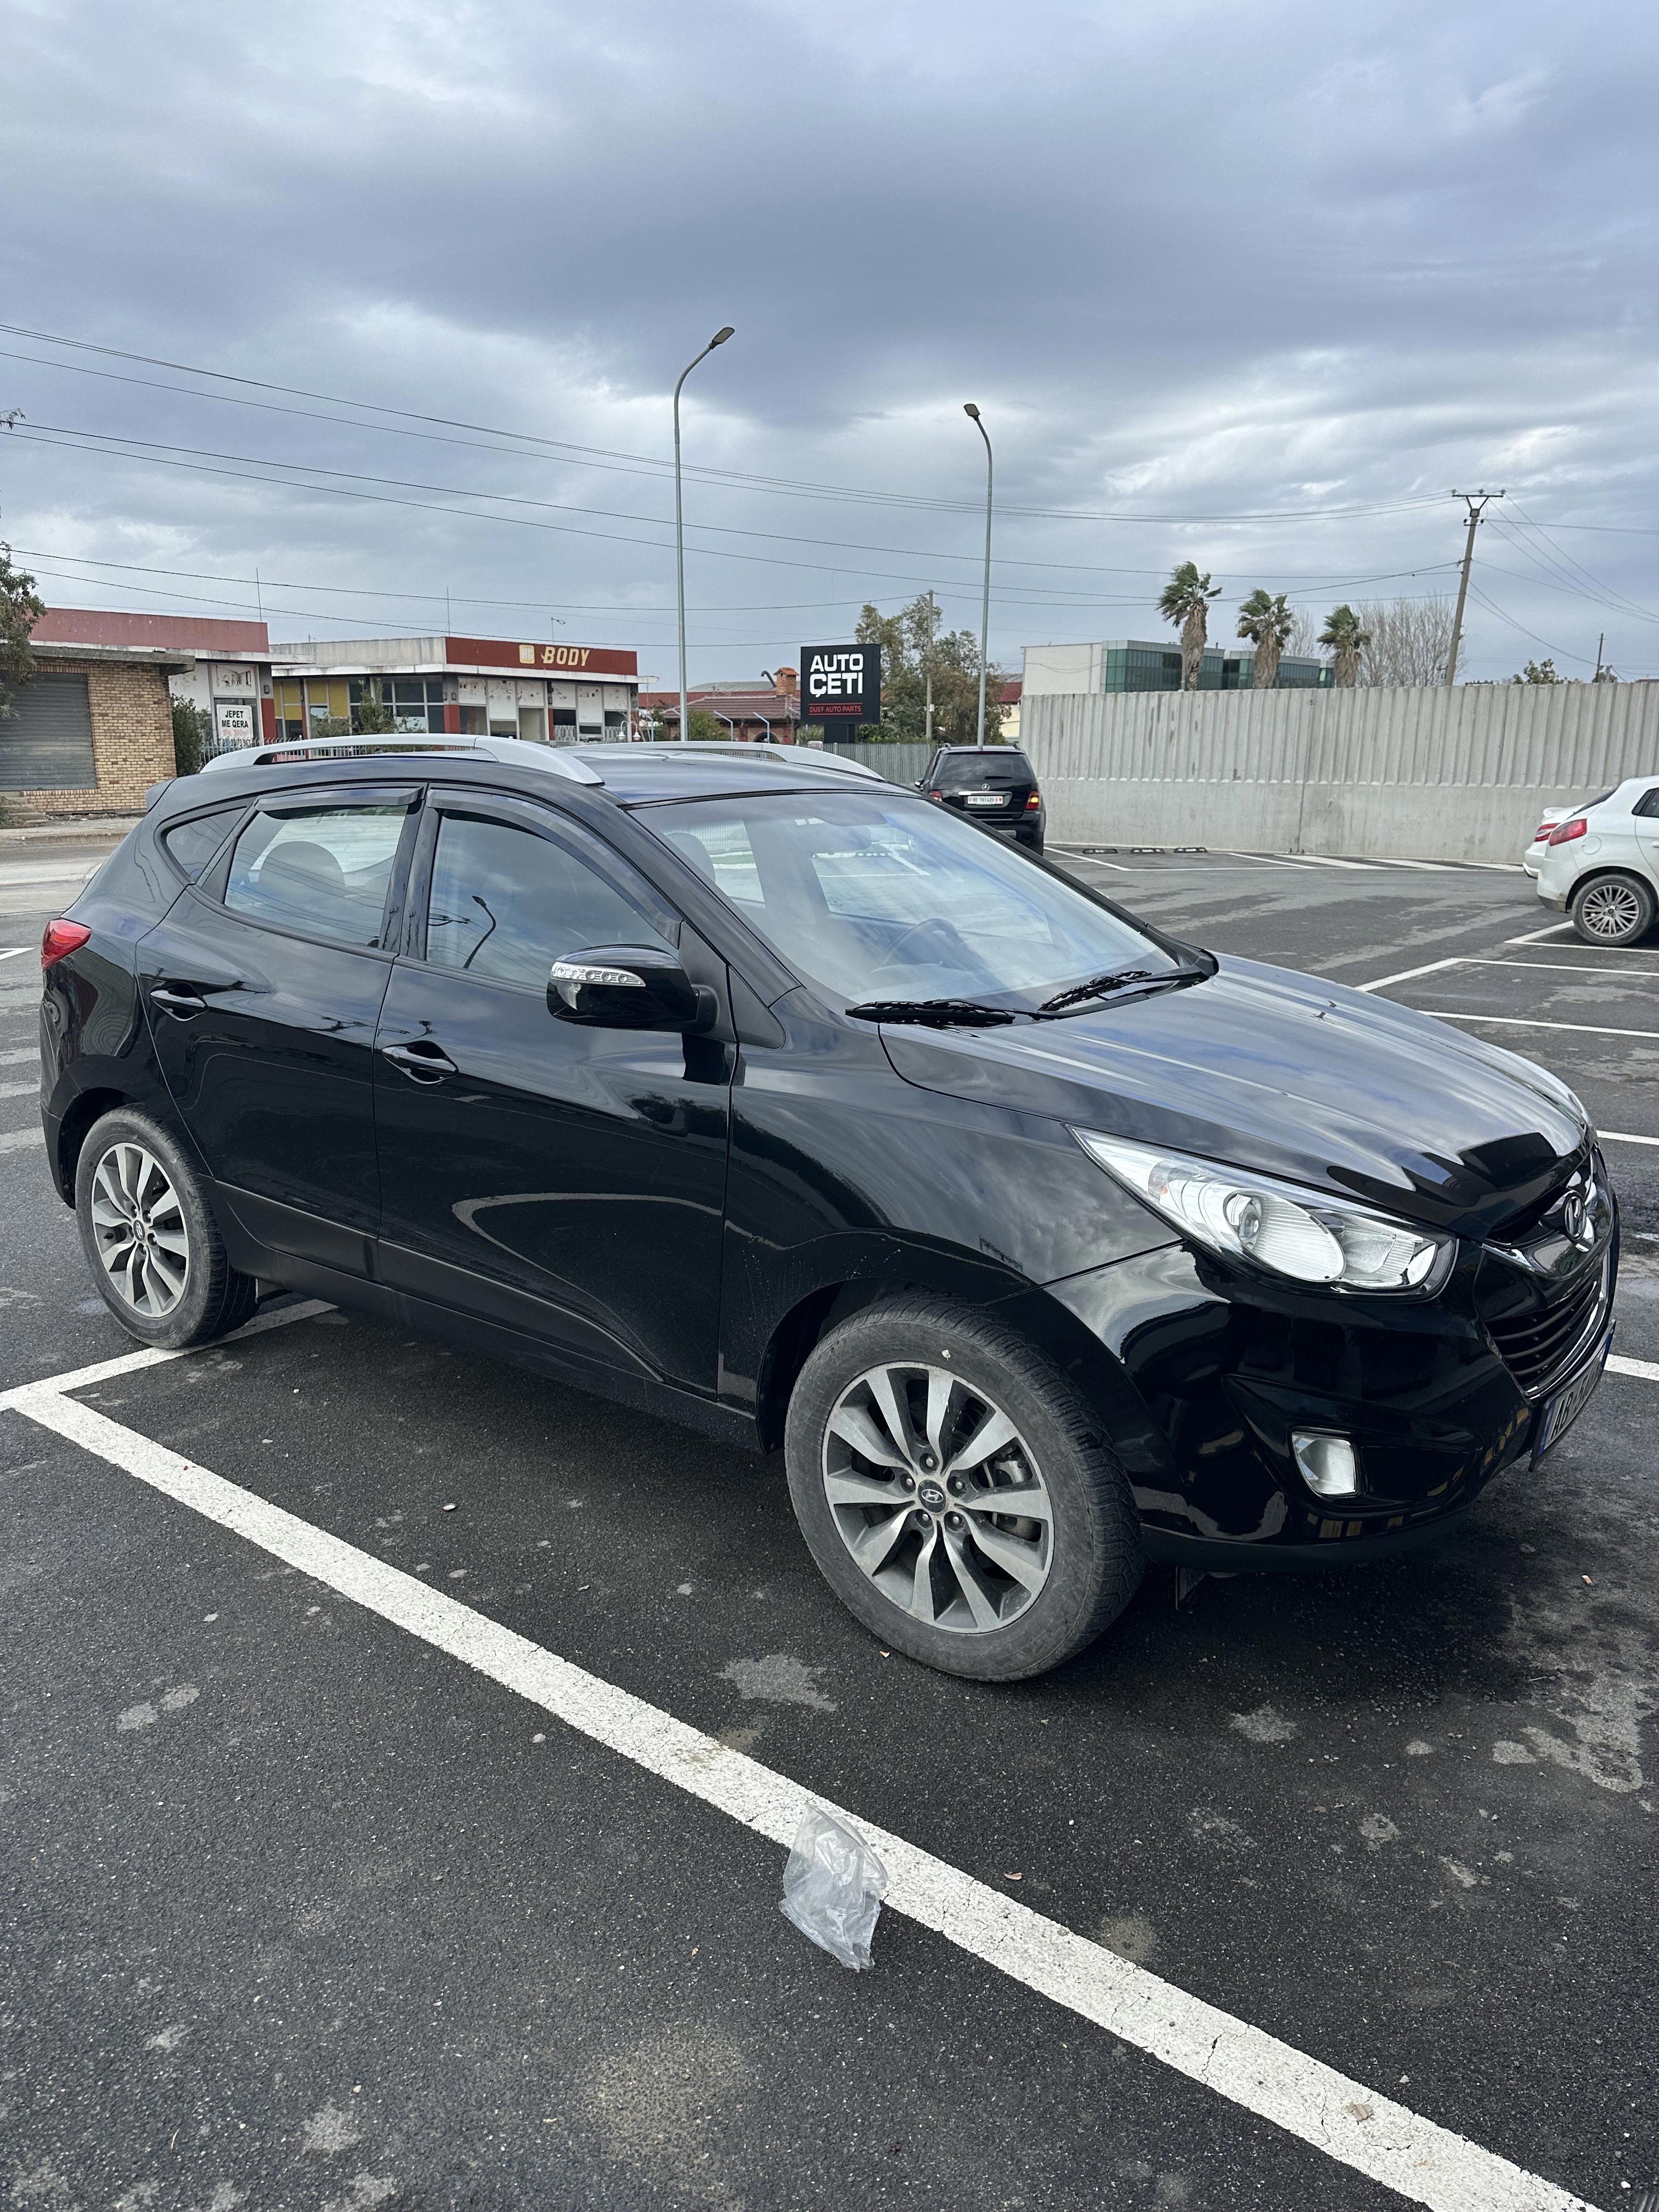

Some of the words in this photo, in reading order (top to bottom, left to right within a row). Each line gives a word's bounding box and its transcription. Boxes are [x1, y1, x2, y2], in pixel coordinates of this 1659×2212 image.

[543, 646, 590, 667] BODY
[810, 653, 864, 673] AUTO
[809, 672, 863, 698] ÇETI
[225, 710, 244, 718] JEPET
[232, 720, 249, 728] QERA
